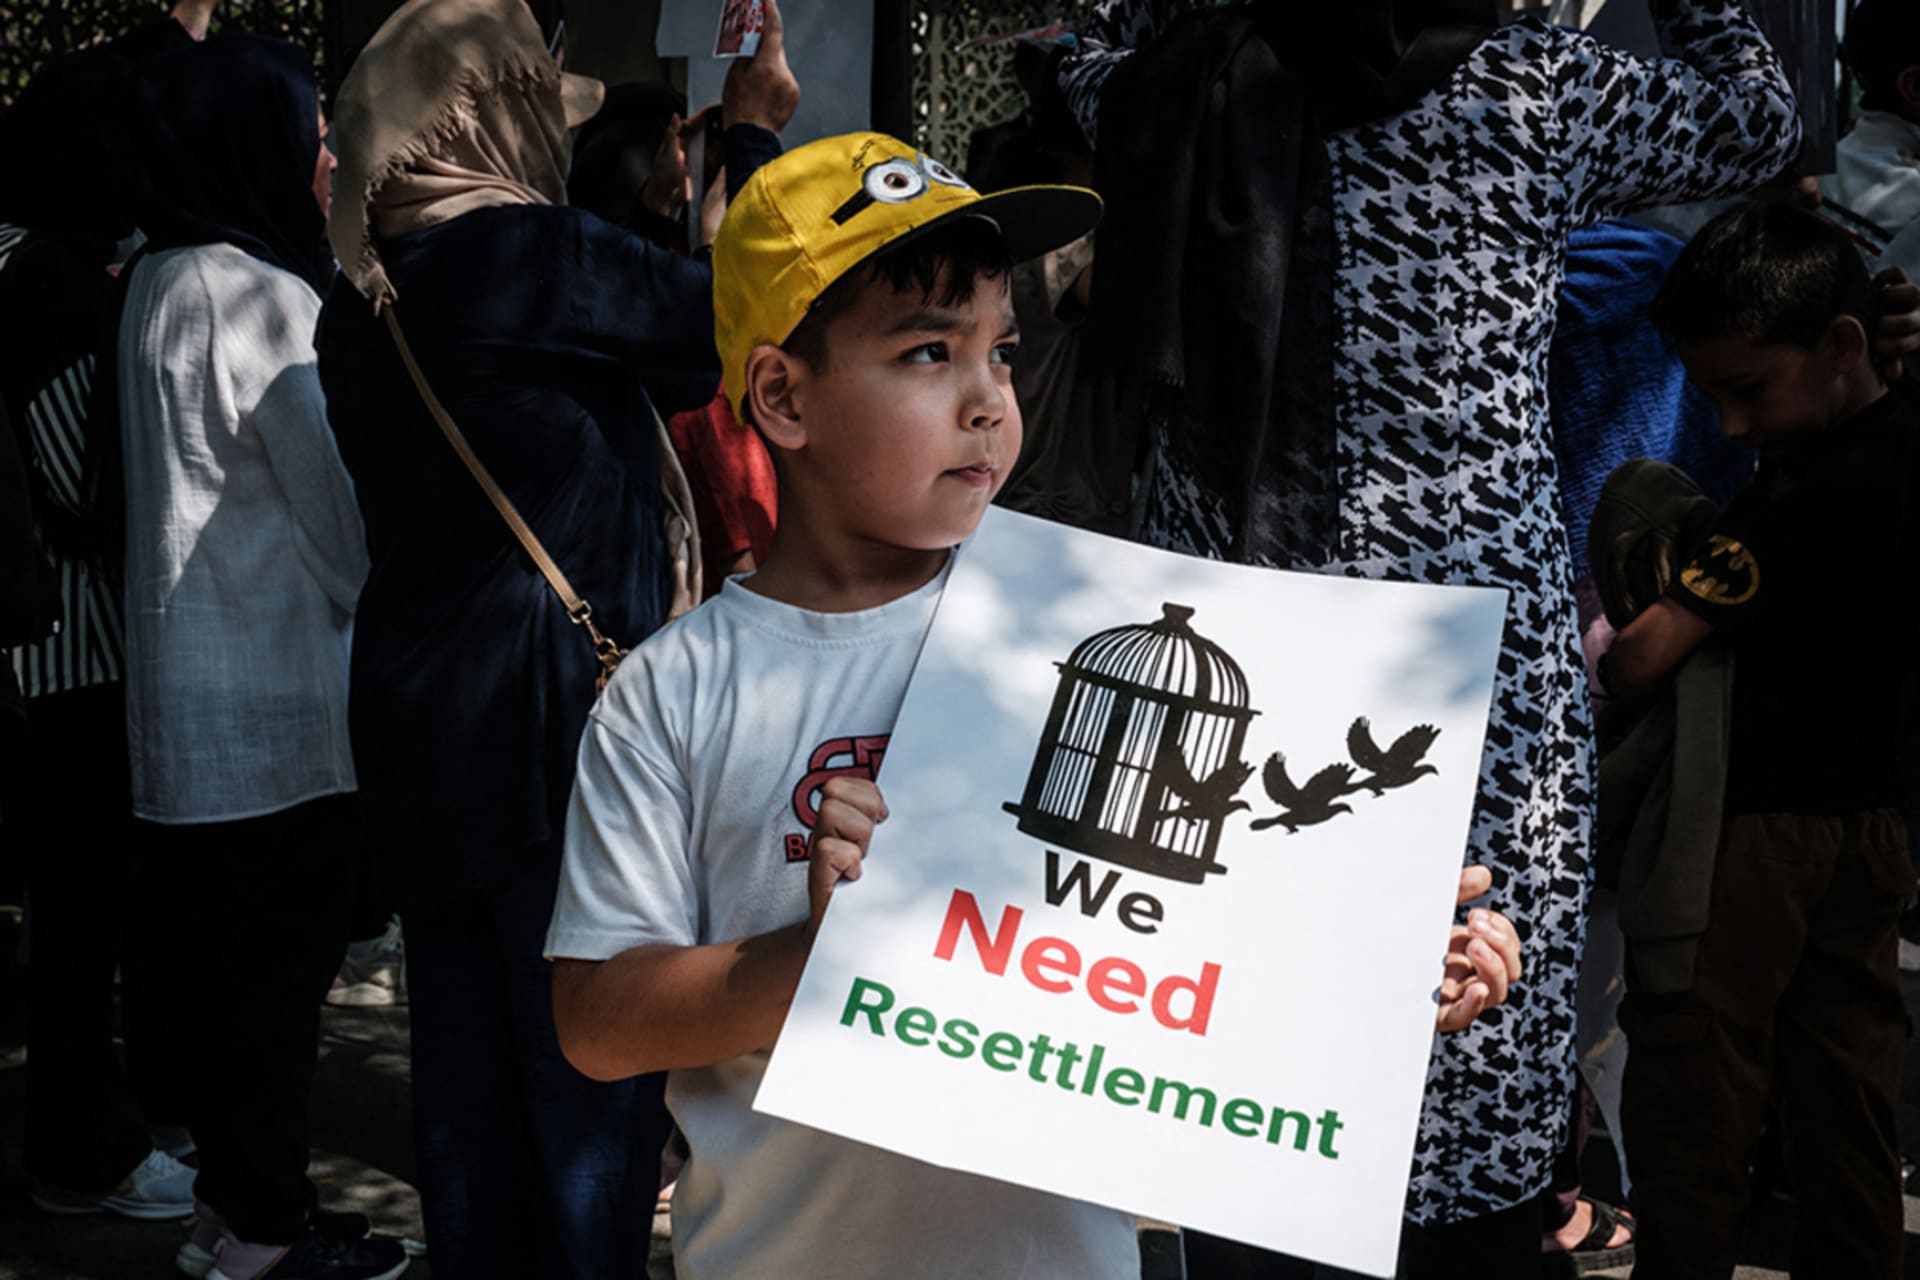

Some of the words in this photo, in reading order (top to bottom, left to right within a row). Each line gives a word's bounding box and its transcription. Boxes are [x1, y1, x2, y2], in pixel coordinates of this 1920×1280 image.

[933, 888, 1223, 1037] Need
[1044, 849, 1165, 935] We
[839, 976, 1345, 1160] Resettlement
